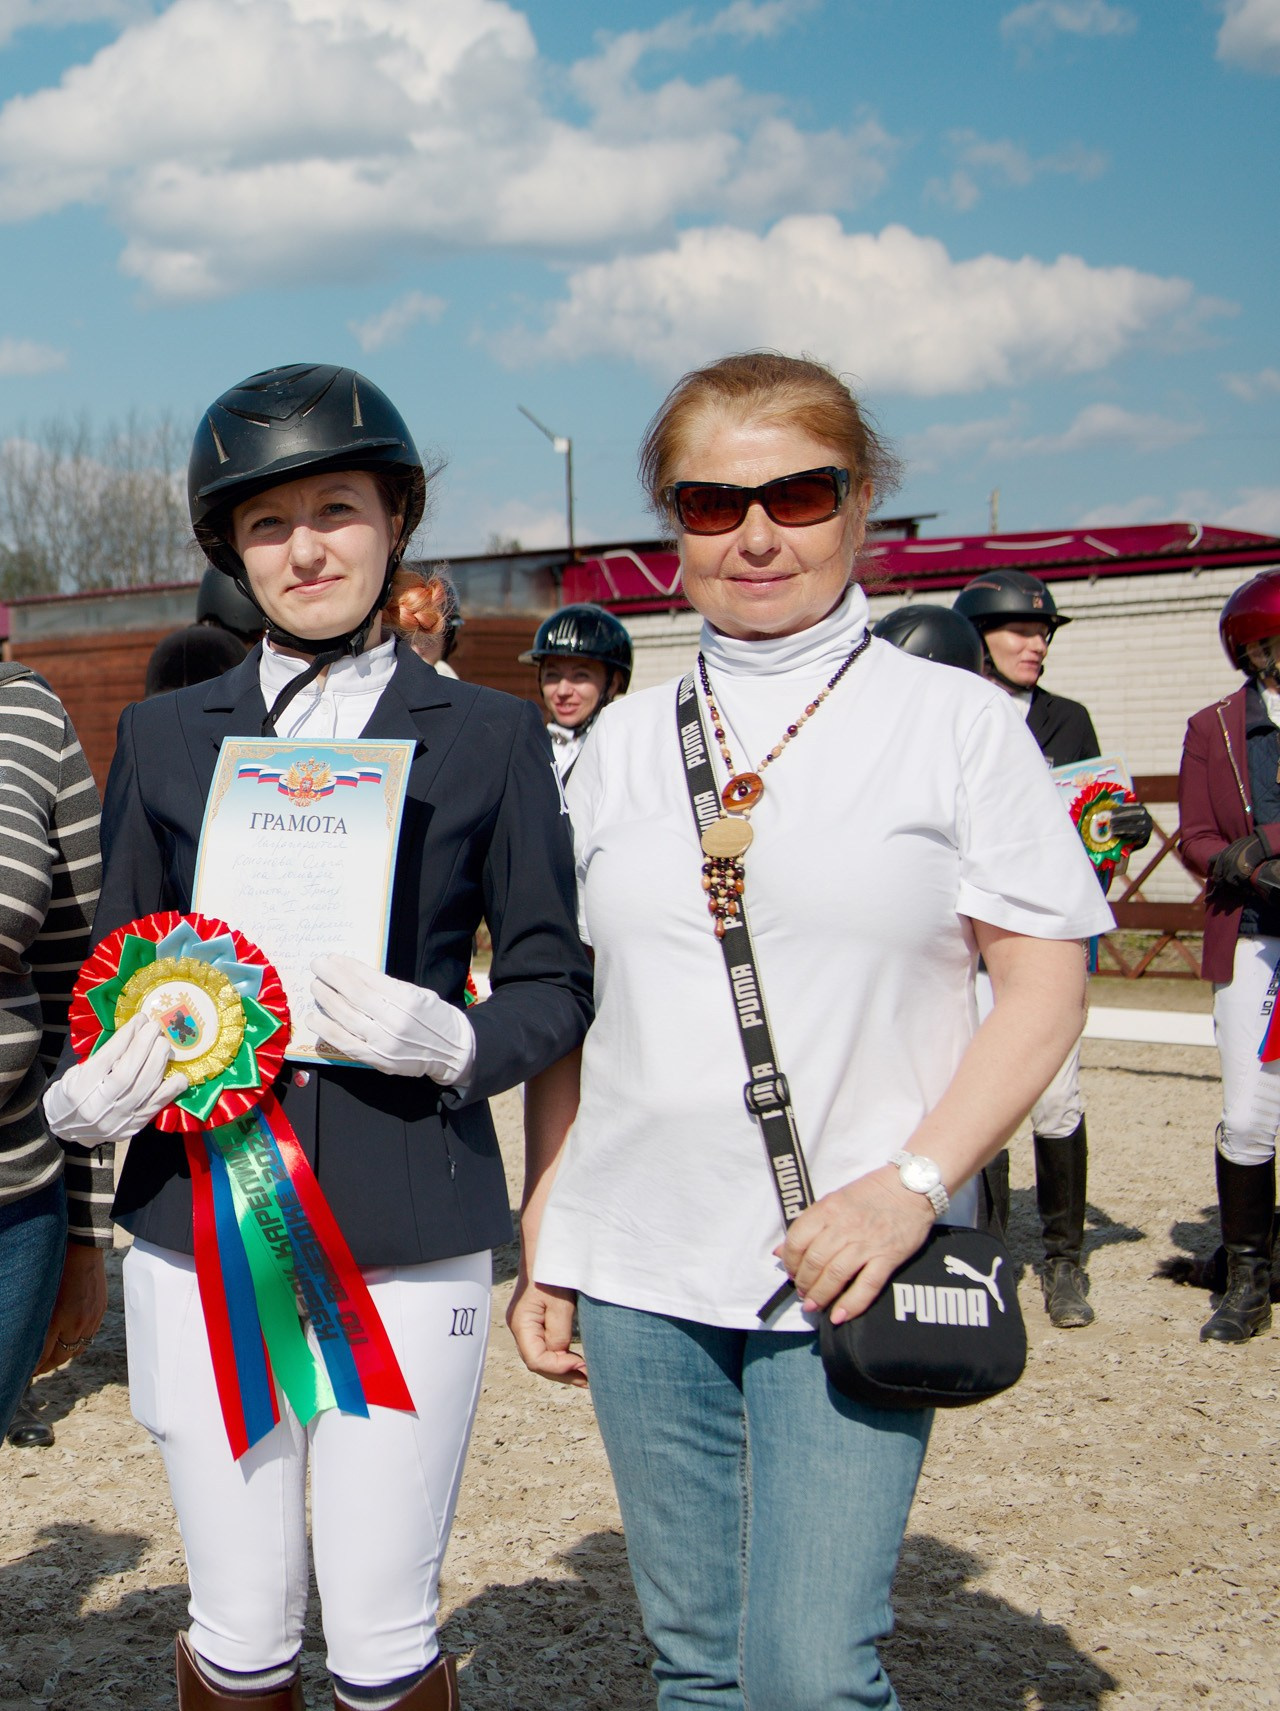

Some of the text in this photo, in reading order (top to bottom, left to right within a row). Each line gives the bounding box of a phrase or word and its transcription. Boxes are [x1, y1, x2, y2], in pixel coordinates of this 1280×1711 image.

[680, 719, 706, 770] PUMA
[249, 812, 348, 834] ГРАМОТА
[694, 790, 720, 837] UMA
[730, 962, 764, 1029] PUMA
[772, 1154, 803, 1221] PUMA
[335, 1309, 369, 1346] ПО
[892, 1282, 990, 1328] PUMA
